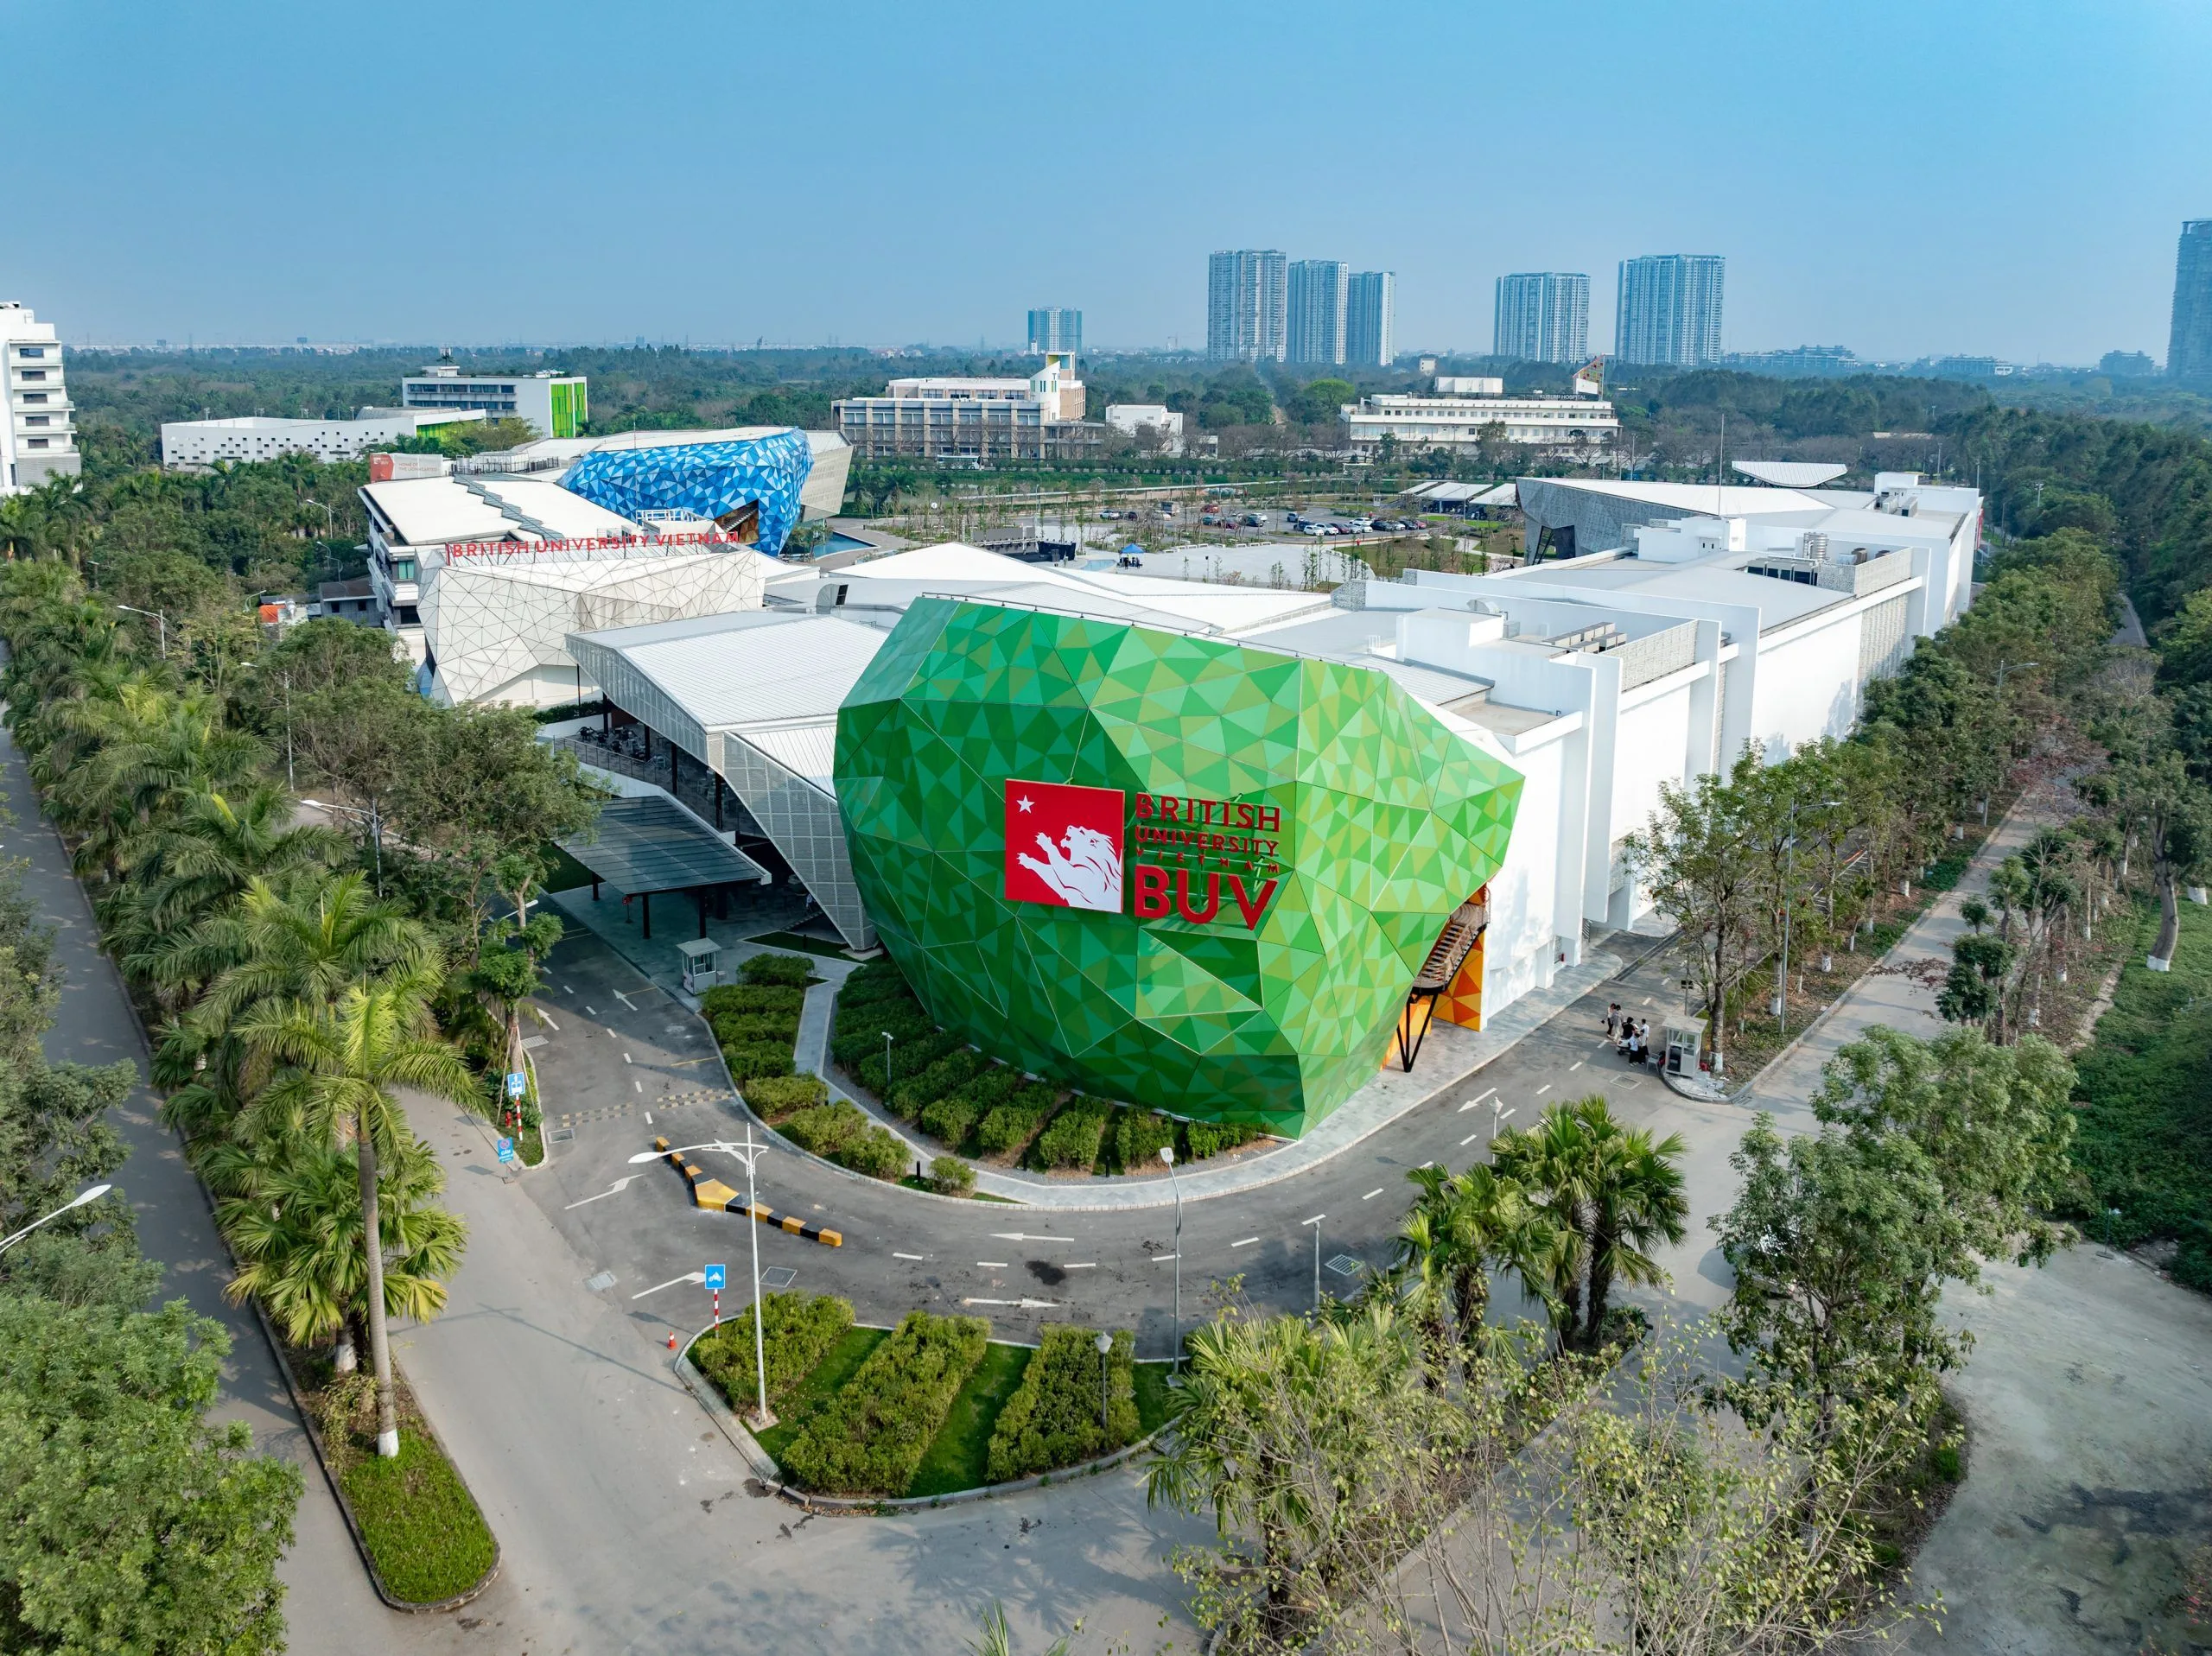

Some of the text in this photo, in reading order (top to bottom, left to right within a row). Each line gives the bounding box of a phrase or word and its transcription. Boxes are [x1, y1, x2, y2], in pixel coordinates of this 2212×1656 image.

[453, 530, 741, 557] BRITISH UNIVERSITY VIETNAM
[1135, 792, 1281, 833] BRITISH
[1135, 824, 1279, 857] UNIVERSITY
[1135, 846, 1280, 874] VIETNAM
[1135, 864, 1279, 931] BUV
